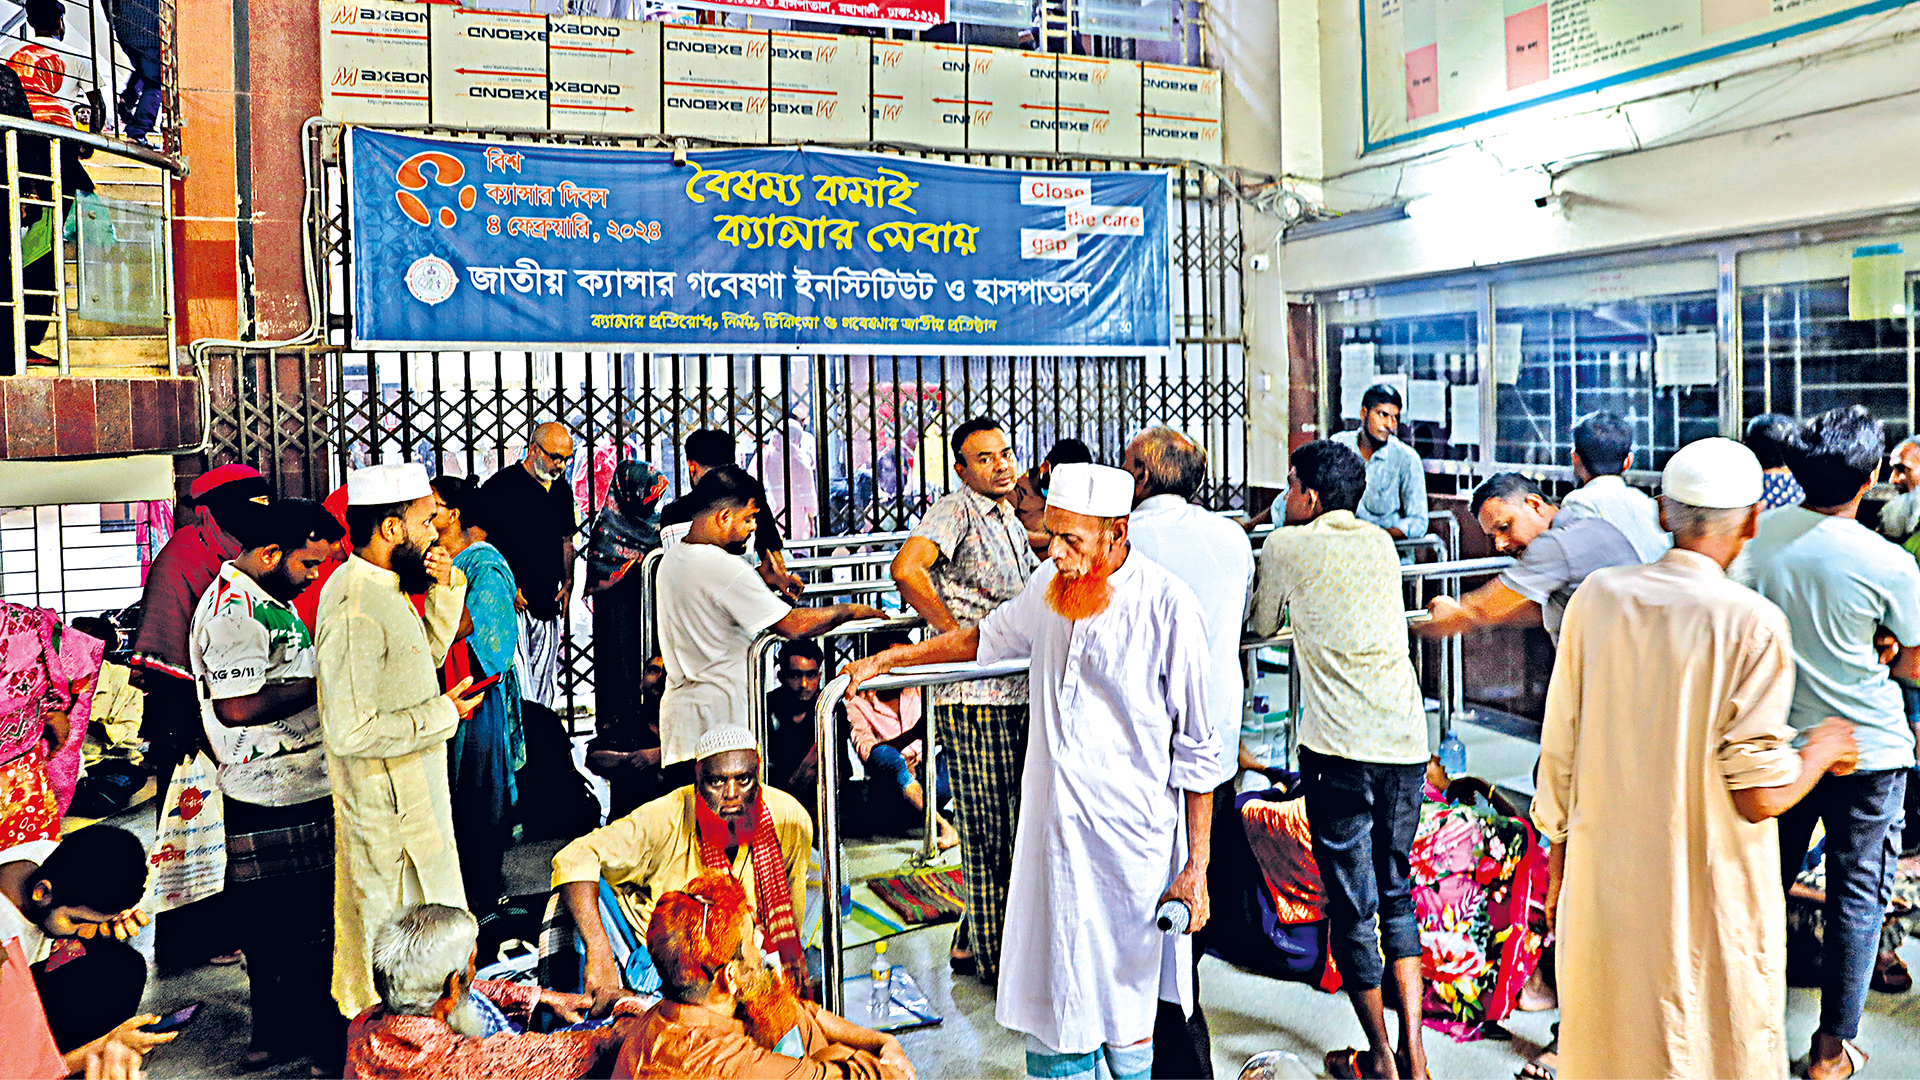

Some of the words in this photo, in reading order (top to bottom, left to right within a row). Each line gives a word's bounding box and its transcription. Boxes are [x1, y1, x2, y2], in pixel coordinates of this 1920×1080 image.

[484, 147, 524, 174] বিশ্ব
[484, 182, 555, 206] ক্যান্সার
[557, 180, 609, 209] দিবস
[685, 160, 804, 206] বৈষম্য
[812, 167, 919, 214] কমাই
[1031, 182, 1084, 199] Close
[487, 215, 501, 235] ৪
[606, 220, 662, 243] ২০২৪
[1068, 210, 1096, 227] the
[1102, 214, 1140, 228] care
[714, 213, 859, 250] ক্যান্সার
[867, 221, 980, 256] সেবায়
[1032, 238, 1067, 255] gap
[466, 257, 567, 297] জাতীয়
[573, 268, 678, 300] ক্যান্সার
[686, 270, 786, 300] গবেষণা
[792, 266, 937, 302] ইনস্টিটিউট
[945, 278, 966, 302] ও
[973, 277, 1092, 306] হাসপাতাল
[824, 316, 837, 329] ও
[231, 666, 255, 679] 9/11
